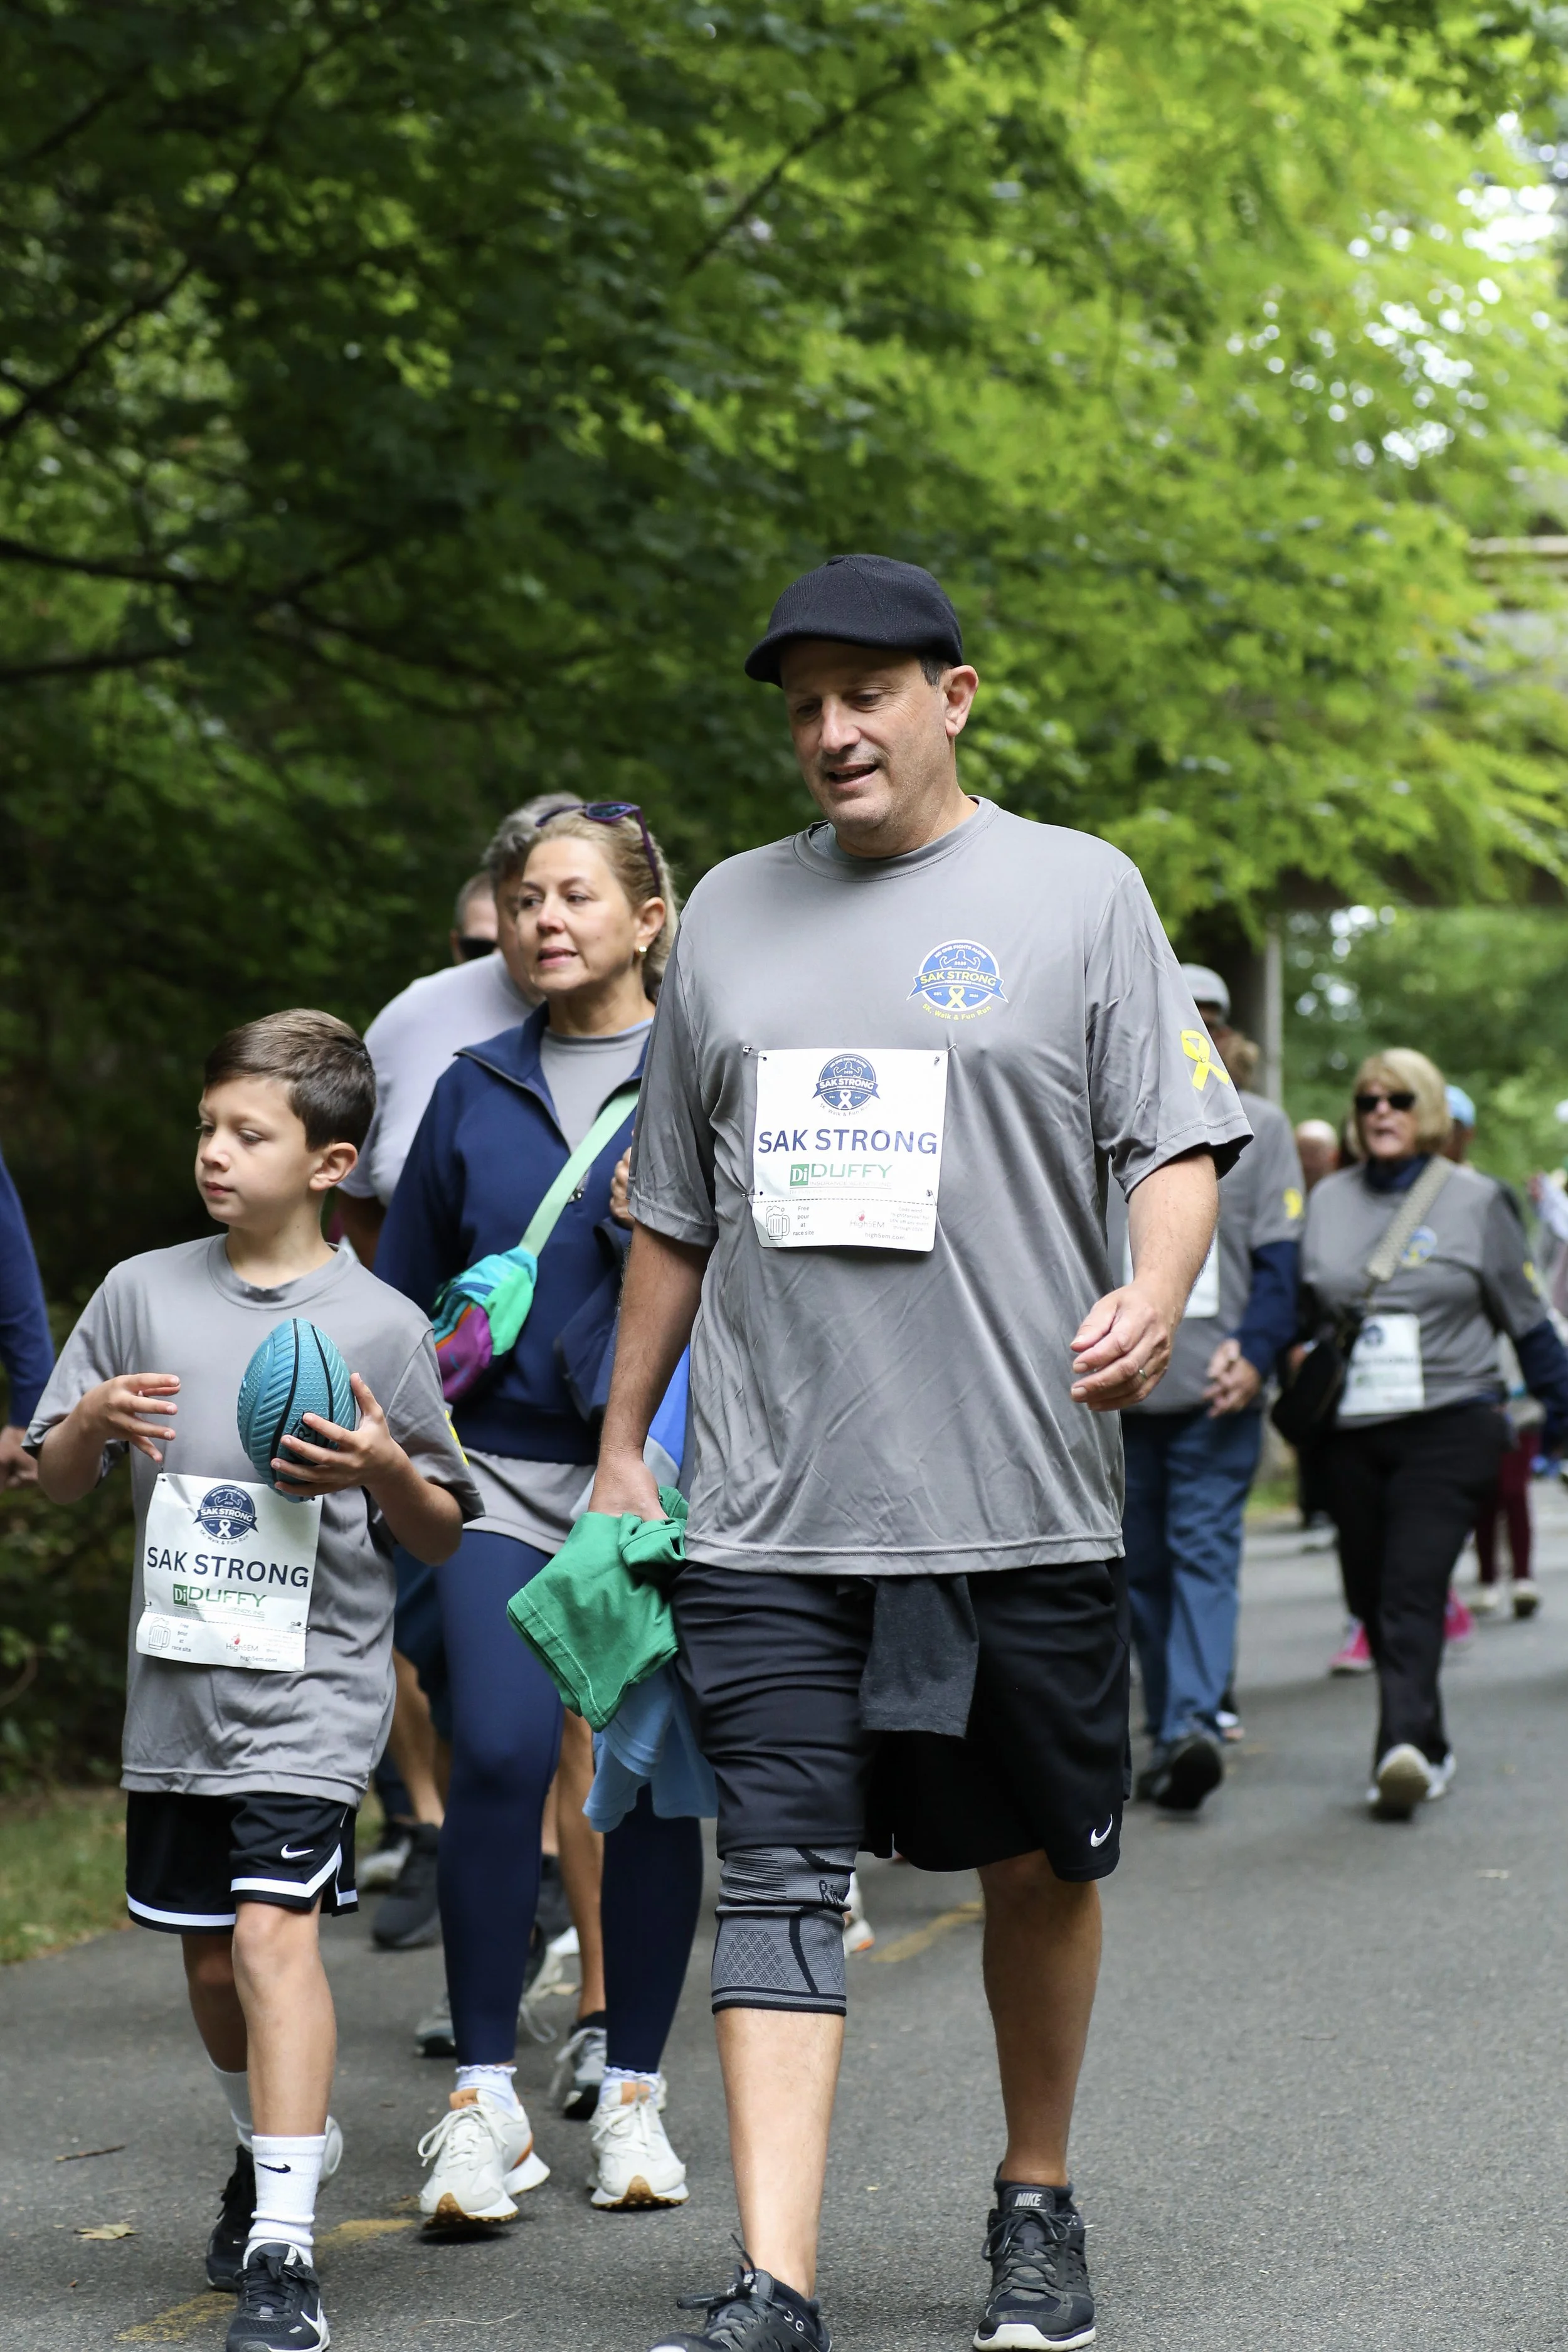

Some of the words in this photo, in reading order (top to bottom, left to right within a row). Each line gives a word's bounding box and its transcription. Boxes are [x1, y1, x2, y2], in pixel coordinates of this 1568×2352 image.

[919, 972, 945, 984] SAK
[946, 971, 997, 987] STRONG
[935, 1010, 951, 1020] Walk
[977, 1005, 992, 1016] Run
[819, 1079, 837, 1089] SAK
[839, 1078, 874, 1090] STRONG
[828, 1108, 840, 1116] Walk
[758, 1130, 808, 1153] SAK
[815, 1128, 937, 1155] STRONG
[811, 1163, 893, 1179] DUFFY
[200, 1508, 218, 1516] SAK
[218, 1508, 253, 1522] STRONG
[147, 1547, 188, 1573] SAK
[193, 1554, 309, 1588] STRONG
[189, 1586, 268, 1608] DUFFY
[1014, 2193, 1042, 2207] NIKE
